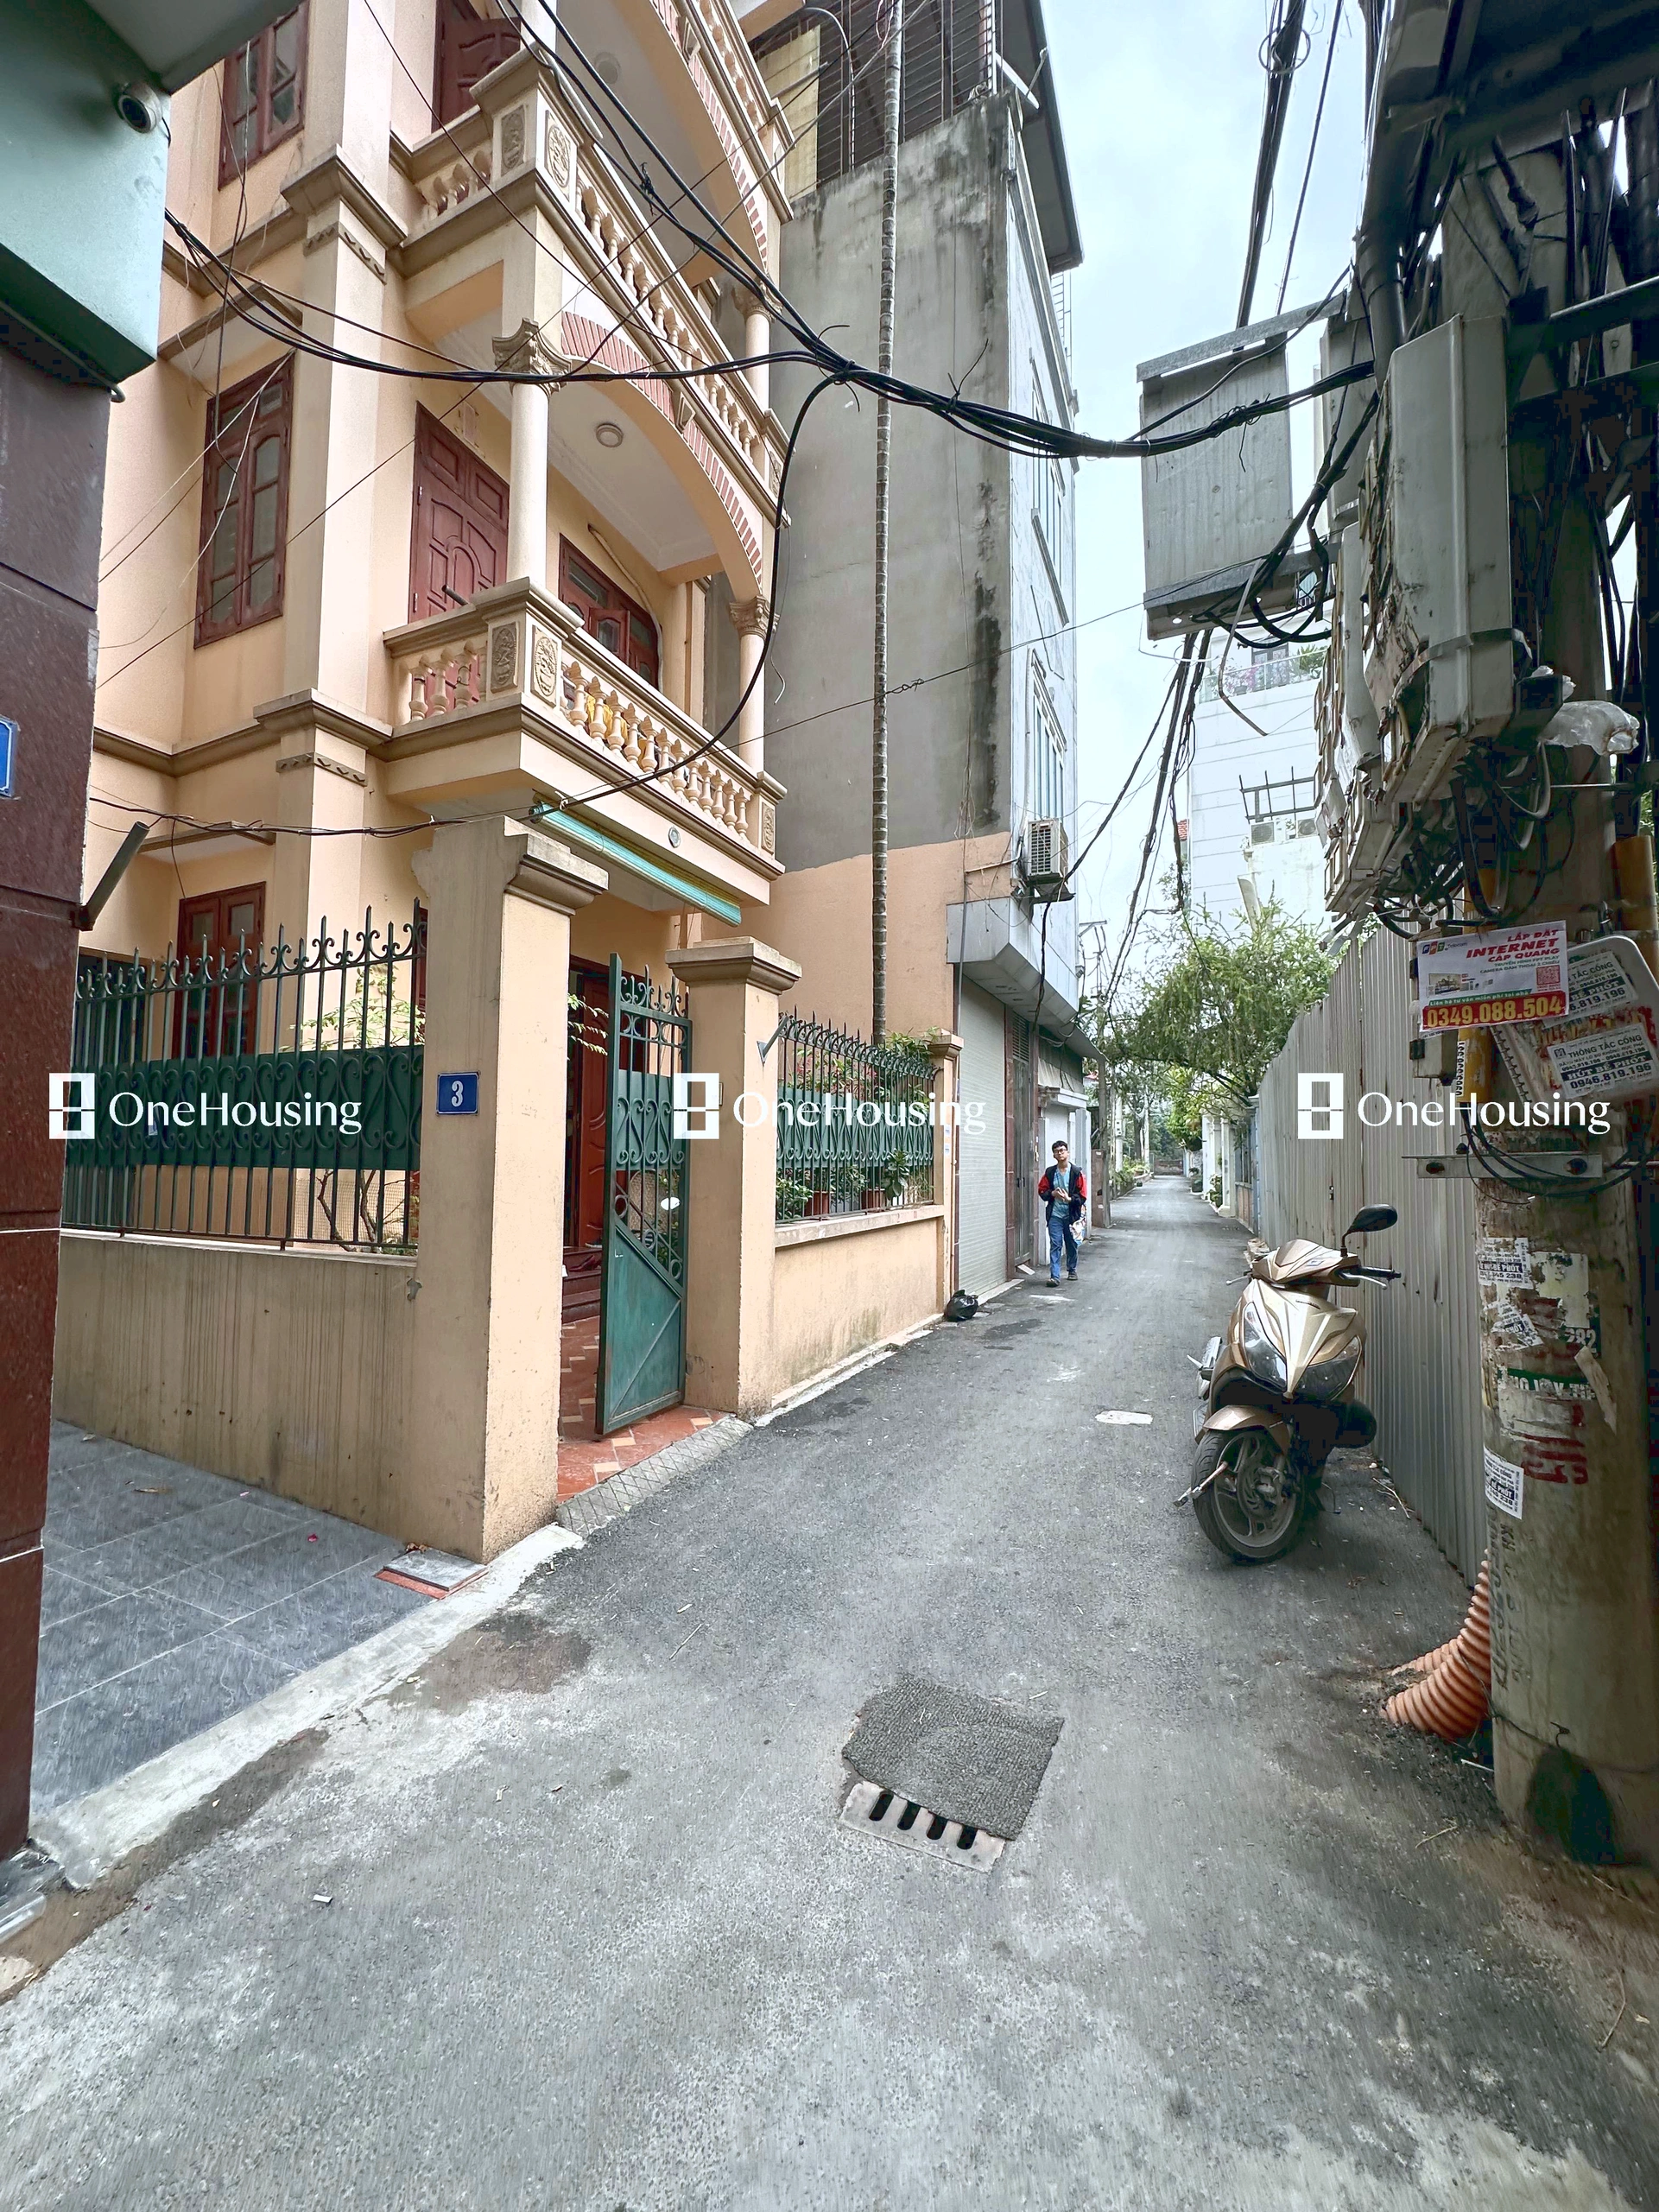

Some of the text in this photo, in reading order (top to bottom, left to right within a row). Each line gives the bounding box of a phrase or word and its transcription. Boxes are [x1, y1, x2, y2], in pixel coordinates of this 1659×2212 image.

[1422, 941, 1445, 954] FPT
[1466, 938, 1559, 959] INTERNET
[1515, 948, 1560, 959] QUANG
[1569, 987, 1625, 1011] 6.819.196
[1427, 996, 1561, 1028] 0349.088.504
[1567, 1045, 1597, 1059] THÔNG
[1618, 1033, 1642, 1046] CỐNG
[1570, 1062, 1651, 1089] 0946.819.196
[452, 1080, 464, 1107] 3
